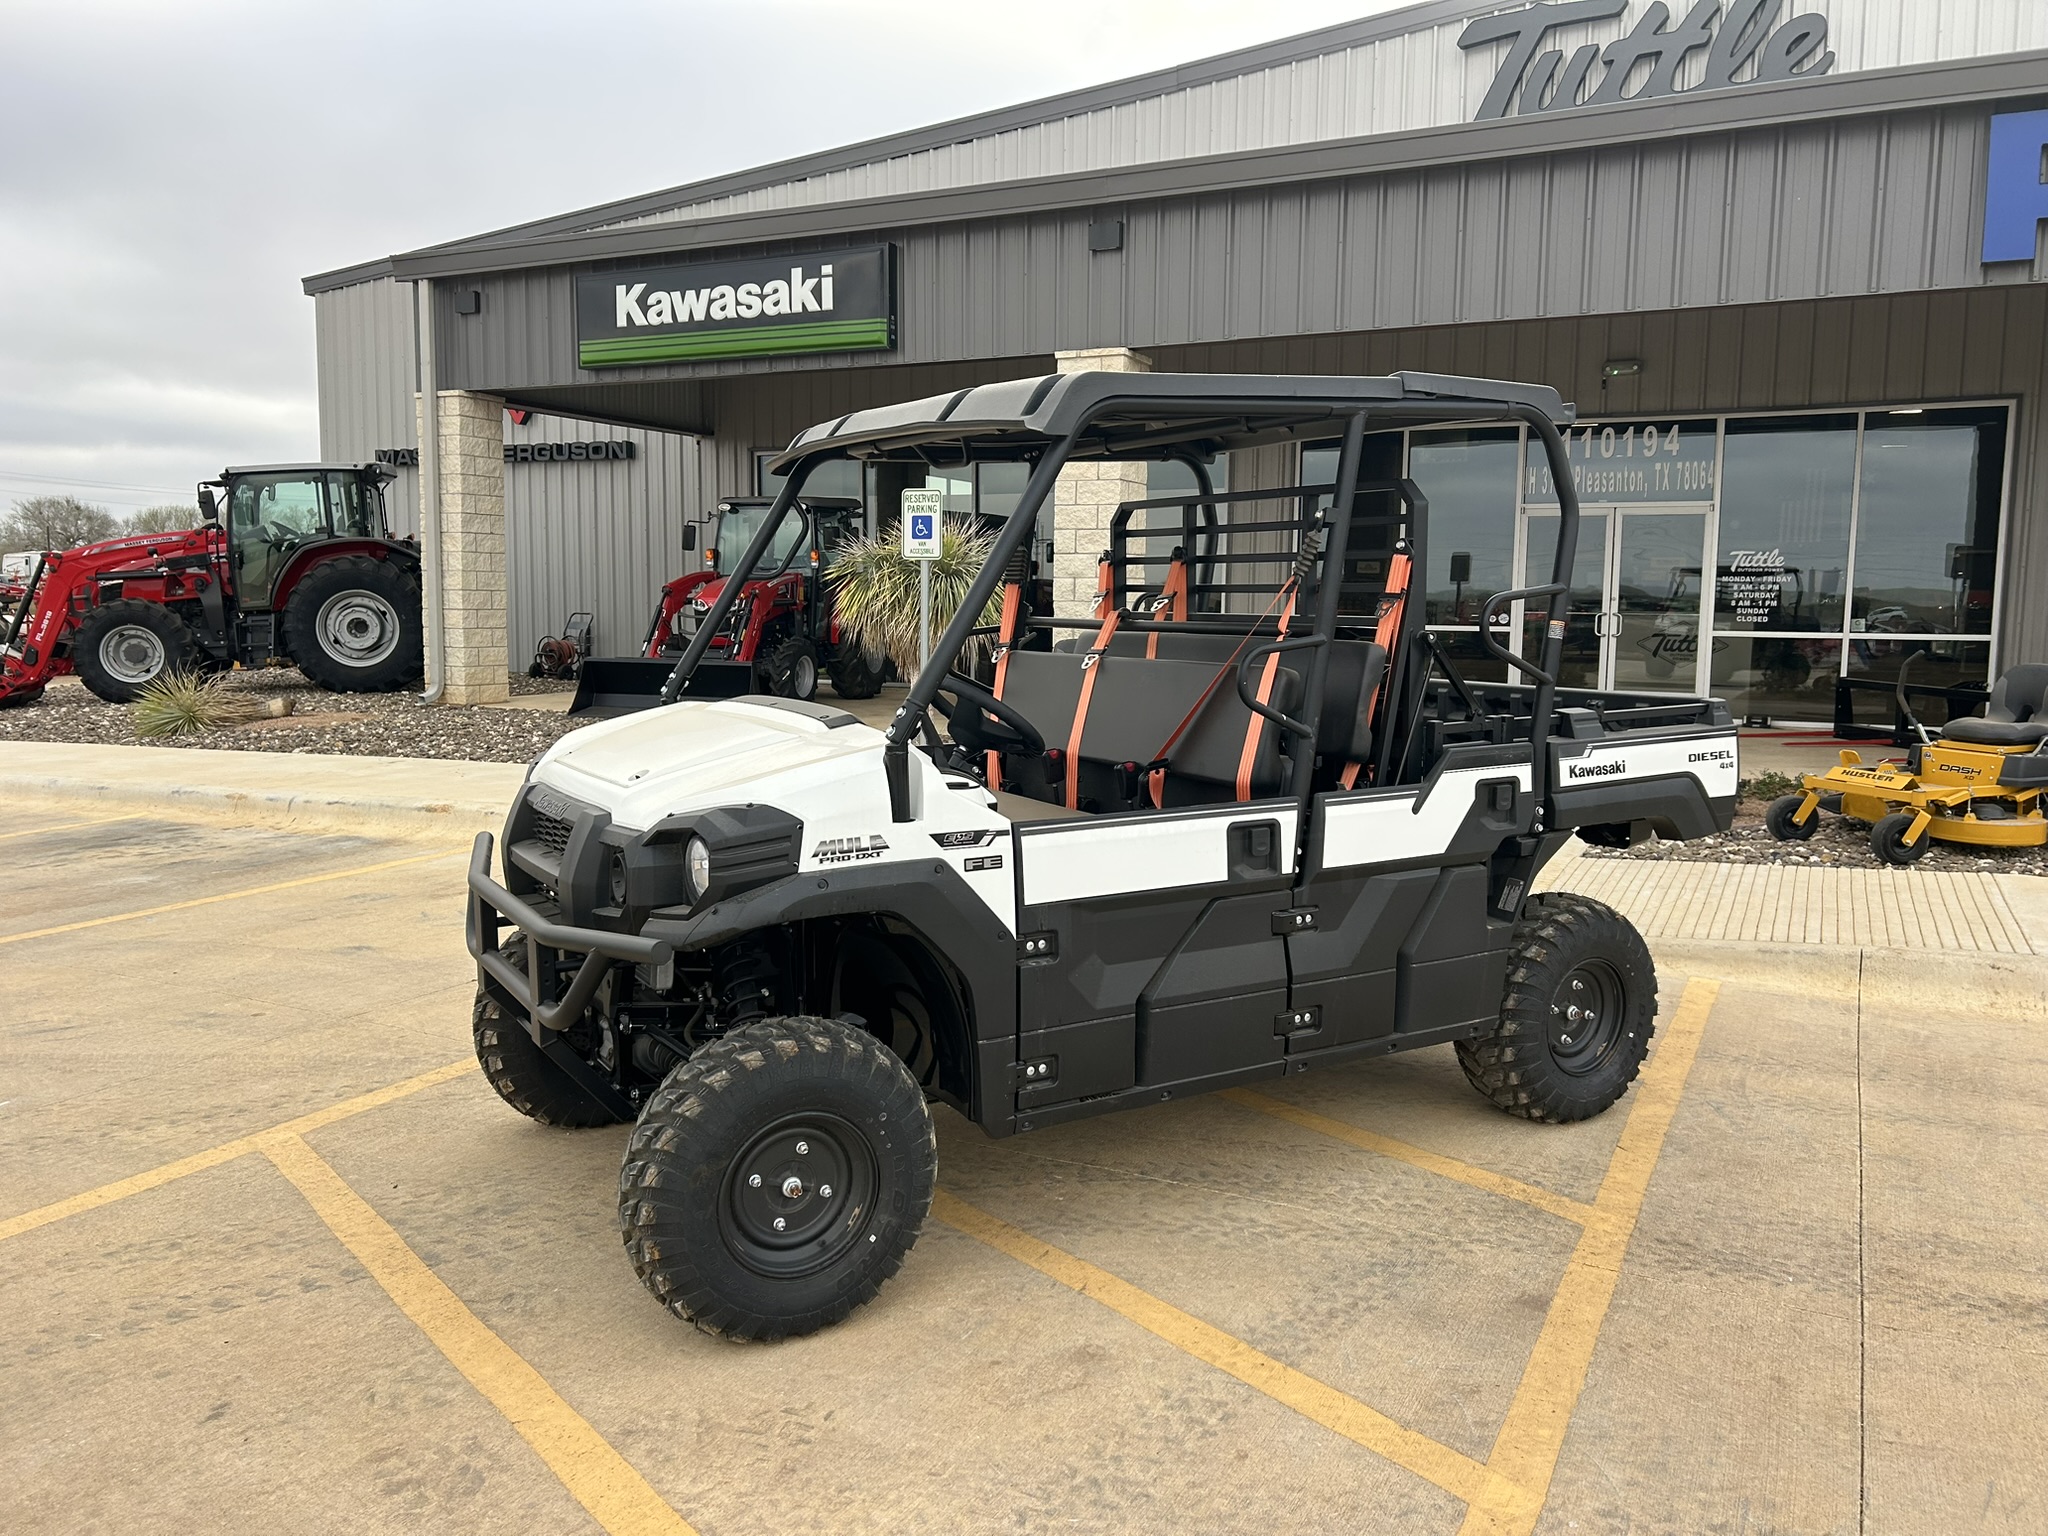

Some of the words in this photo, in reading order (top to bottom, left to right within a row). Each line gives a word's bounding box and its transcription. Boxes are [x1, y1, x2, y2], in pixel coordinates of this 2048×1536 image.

[1457, 0, 1836, 121] Tuttle
[616, 264, 833, 328] Kawasaki
[1561, 424, 1680, 459] 110194
[504, 440, 634, 463] ERGUSON
[1574, 463, 1648, 498] Pleasanton,
[1655, 461, 1670, 491] TX
[1676, 459, 1714, 490] 78064
[905, 494, 940, 503] RESERVED
[907, 505, 938, 514] PARKING
[1729, 548, 1786, 573] Tuttle
[1688, 750, 1734, 763] DIESEL
[1569, 760, 1626, 778] Kawasaki
[1841, 769, 1895, 782] HUSTLER
[1939, 763, 1982, 776] DASH
[811, 834, 891, 858] MULE
[818, 850, 884, 865] PRO-DXT
[965, 856, 1002, 871] FE
